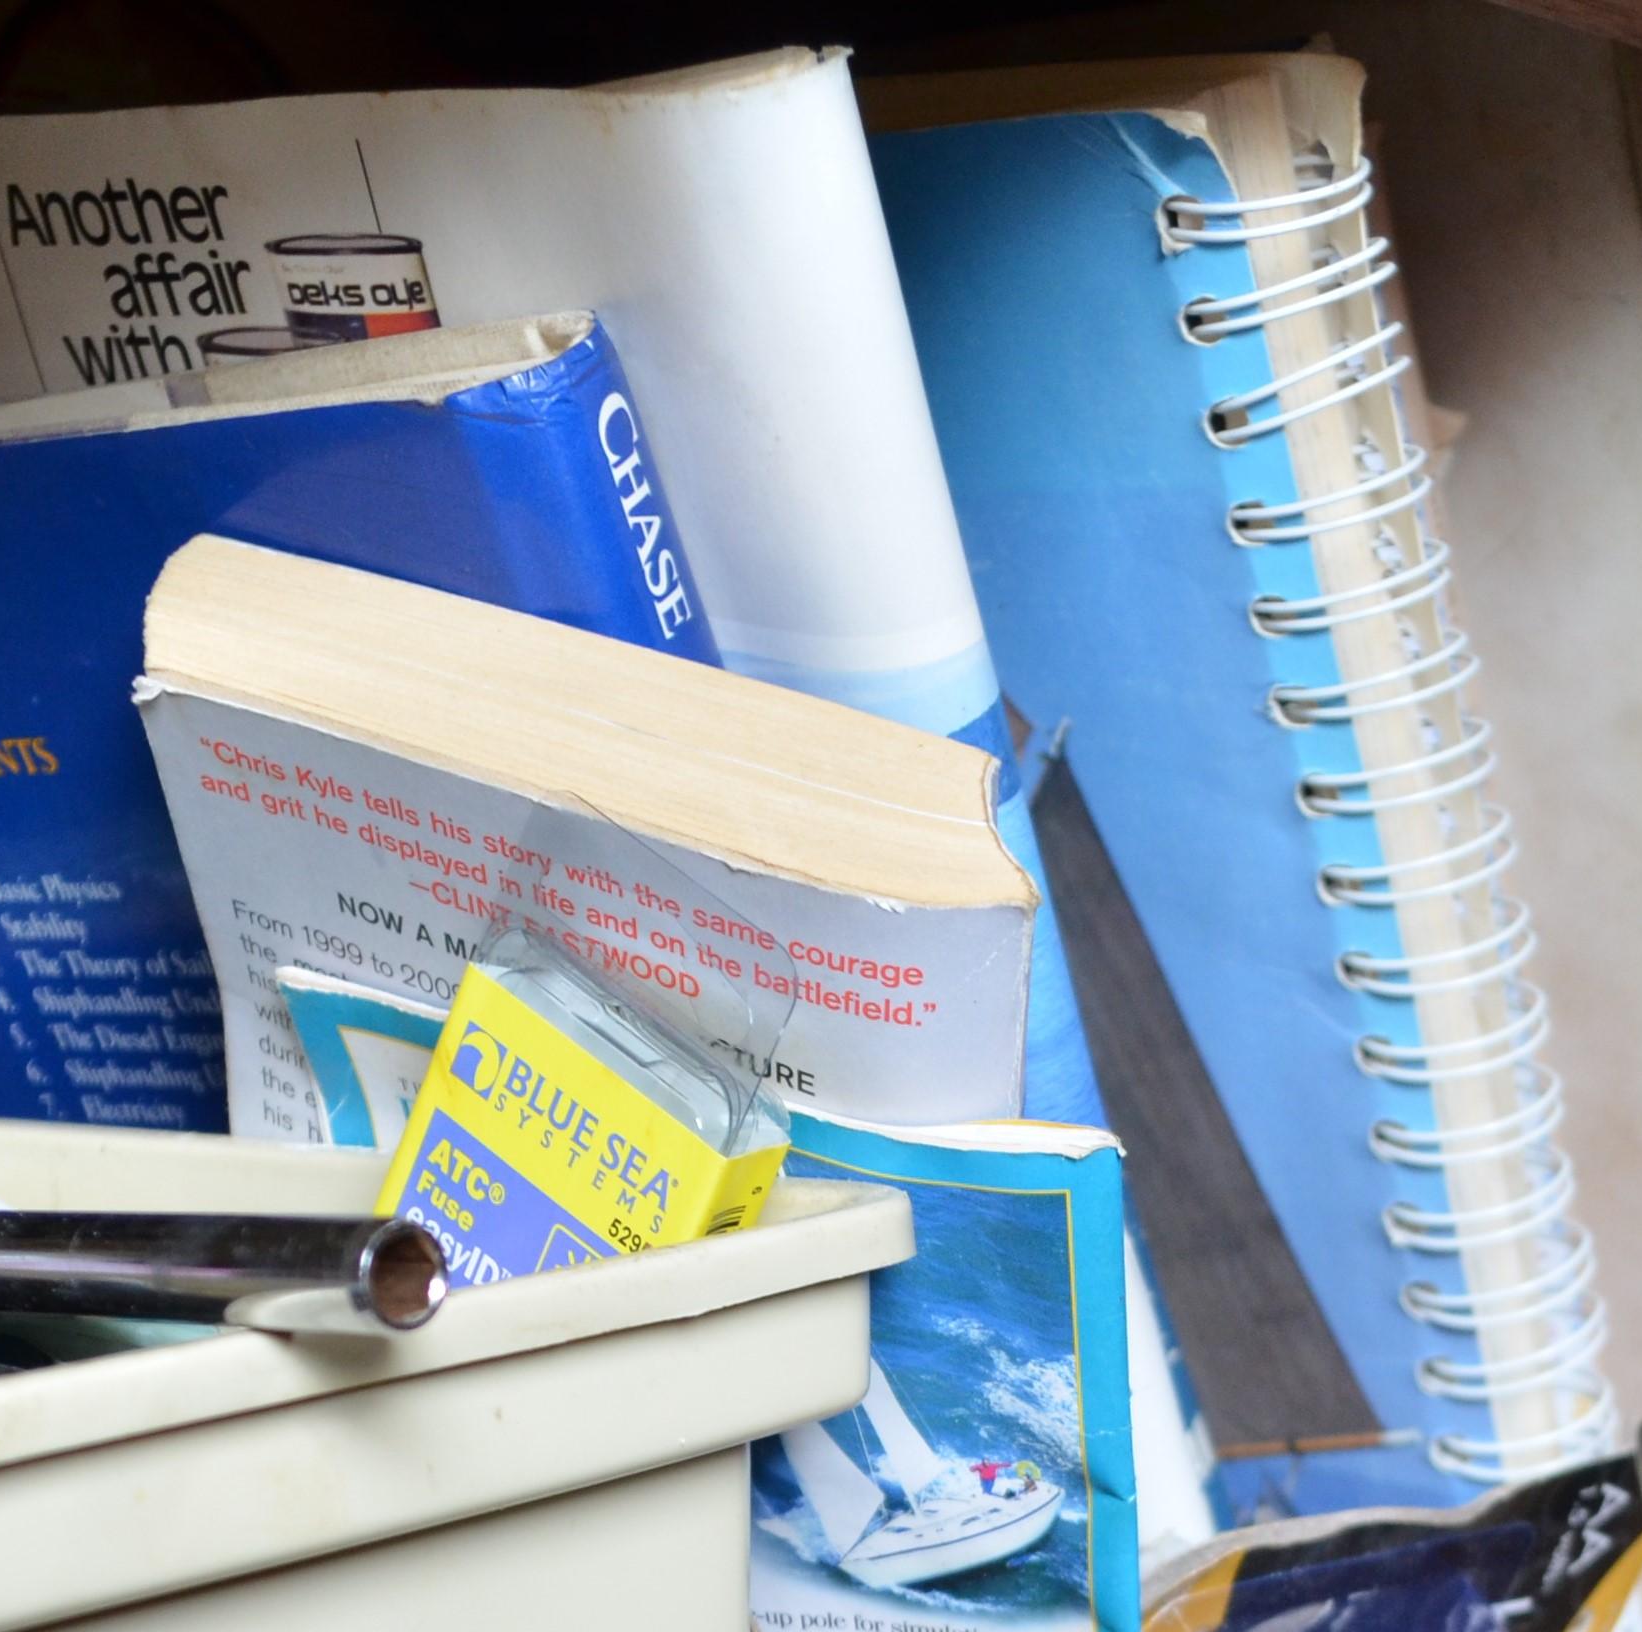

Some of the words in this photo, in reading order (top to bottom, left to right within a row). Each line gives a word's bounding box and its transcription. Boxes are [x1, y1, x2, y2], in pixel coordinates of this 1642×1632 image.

[6, 177, 229, 247] Another
[103, 250, 250, 319] affair
[63, 325, 194, 387] with
[598, 391, 692, 640] CHASE
[41, 873, 123, 908] Physics
[199, 772, 252, 803] and
[260, 791, 307, 822] grit
[313, 805, 349, 835] he
[358, 824, 489, 886] displayed
[499, 870, 523, 900] in
[532, 885, 576, 918] life
[586, 903, 639, 941] and
[649, 930, 686, 957] on
[696, 942, 744, 979] the
[295, 765, 355, 804] Kyle
[362, 789, 421, 827] tells
[430, 810, 473, 845] his
[482, 833, 552, 876] story
[565, 861, 625, 899] with
[634, 882, 682, 919] the
[692, 908, 777, 952] same
[787, 939, 926, 989] courage
[0, 910, 87, 945] Stability
[231, 898, 295, 940] From
[303, 924, 364, 966] 1999
[370, 951, 395, 978] to
[239, 932, 279, 965] the
[336, 891, 405, 935] NOW
[416, 923, 435, 948] A
[15, 948, 61, 978] The
[59, 948, 140, 983] Theory
[261, 1065, 297, 1100] the
[502, 1054, 600, 1153] BLUE
[262, 1099, 294, 1132] his
[494, 1092, 665, 1235] SYSTEMS
[415, 1169, 476, 1232] Fuse
[800, 1609, 846, 1632] pole
